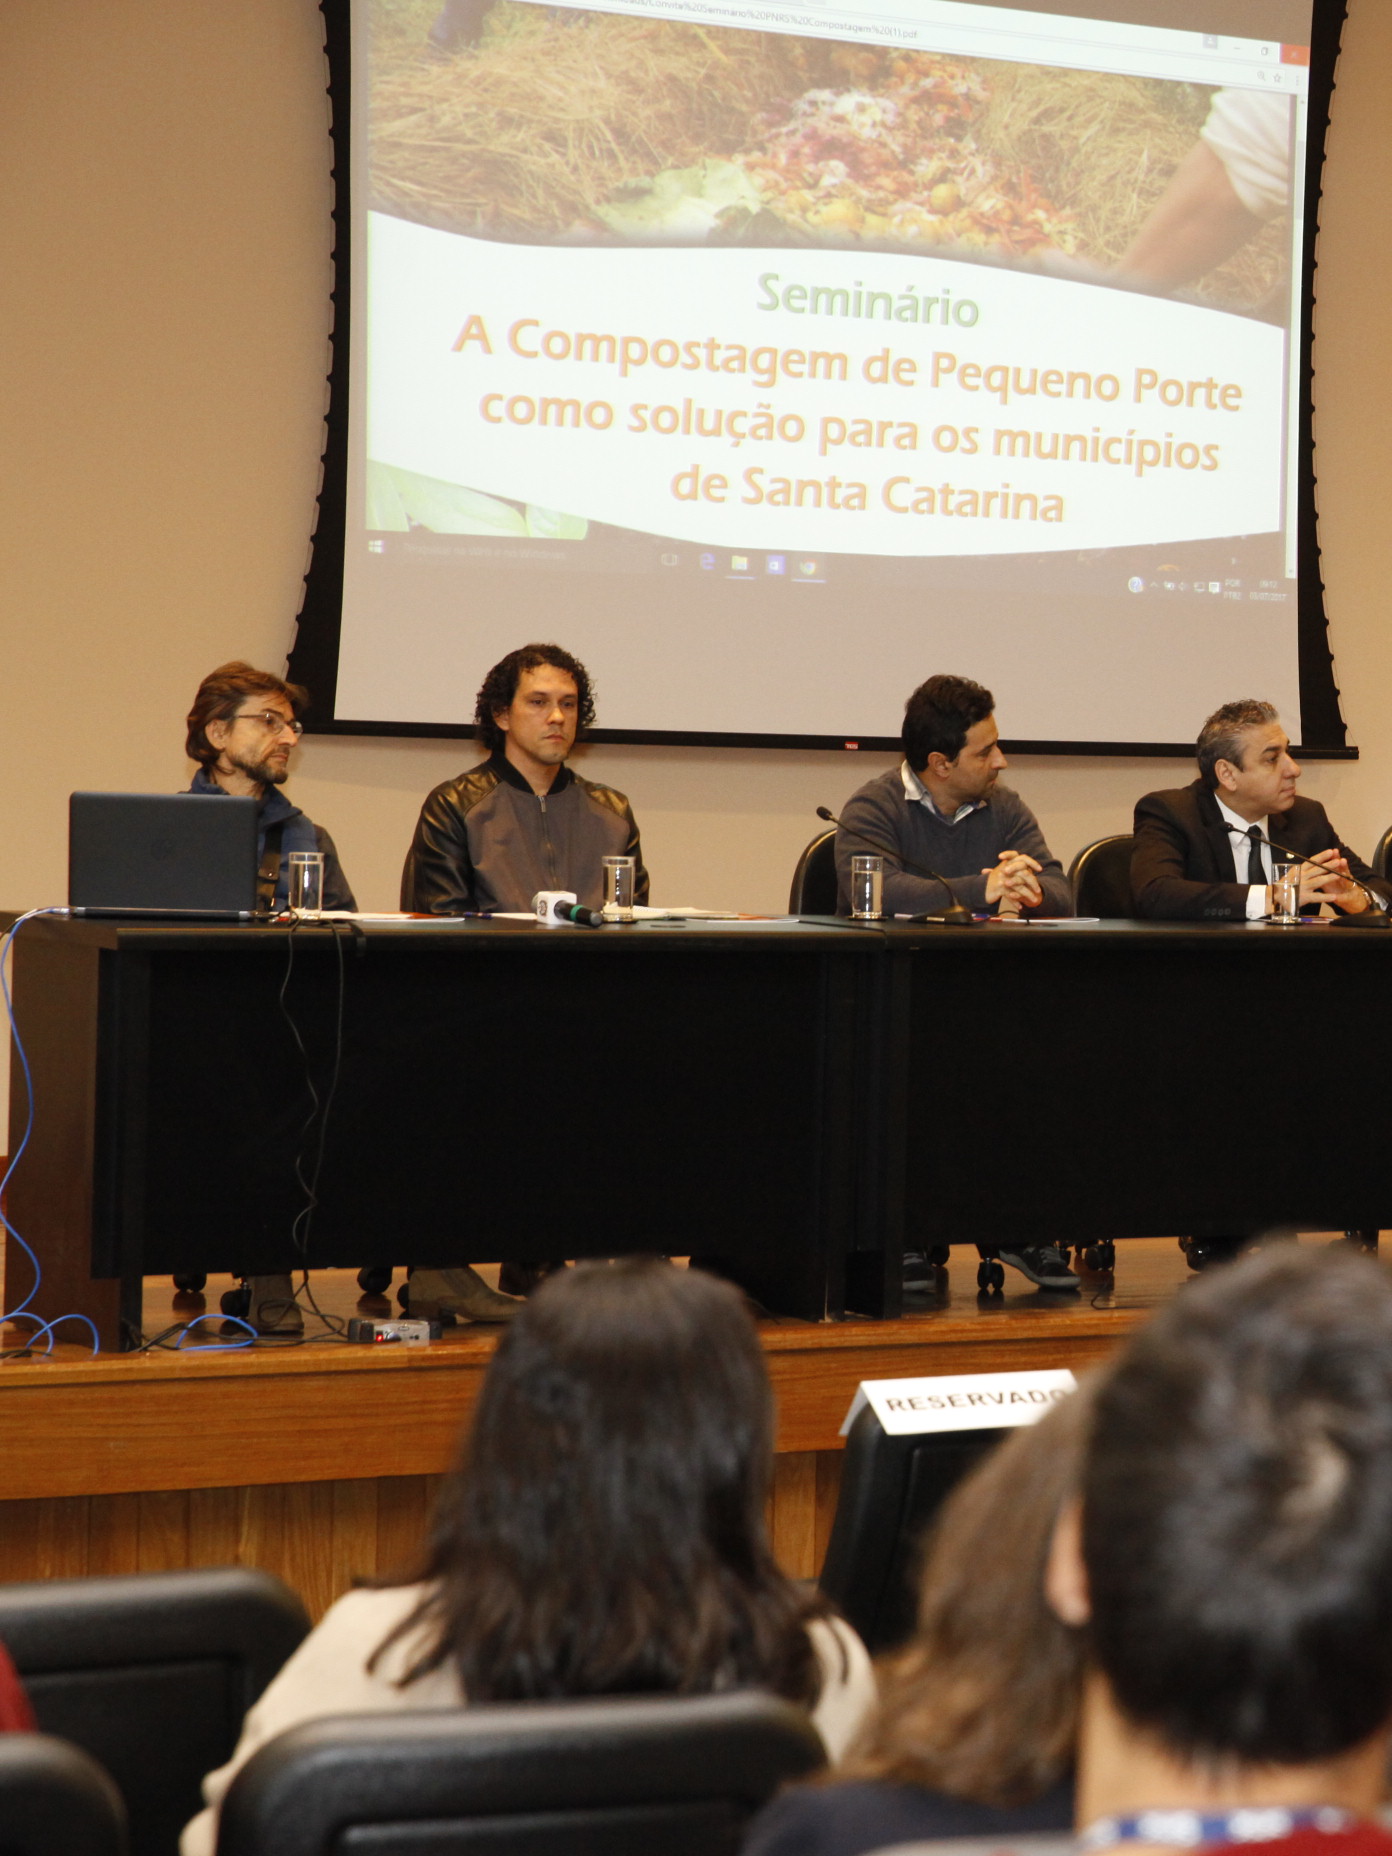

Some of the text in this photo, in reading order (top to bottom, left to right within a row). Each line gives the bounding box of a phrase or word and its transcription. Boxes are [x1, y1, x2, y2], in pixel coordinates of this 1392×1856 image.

[761, 274, 982, 327] Seminário
[453, 315, 1245, 412] A Compostagem de Pequeno Porte
[481, 392, 1222, 477] como solução para os municípios
[671, 463, 1067, 523] de Santa Catarina
